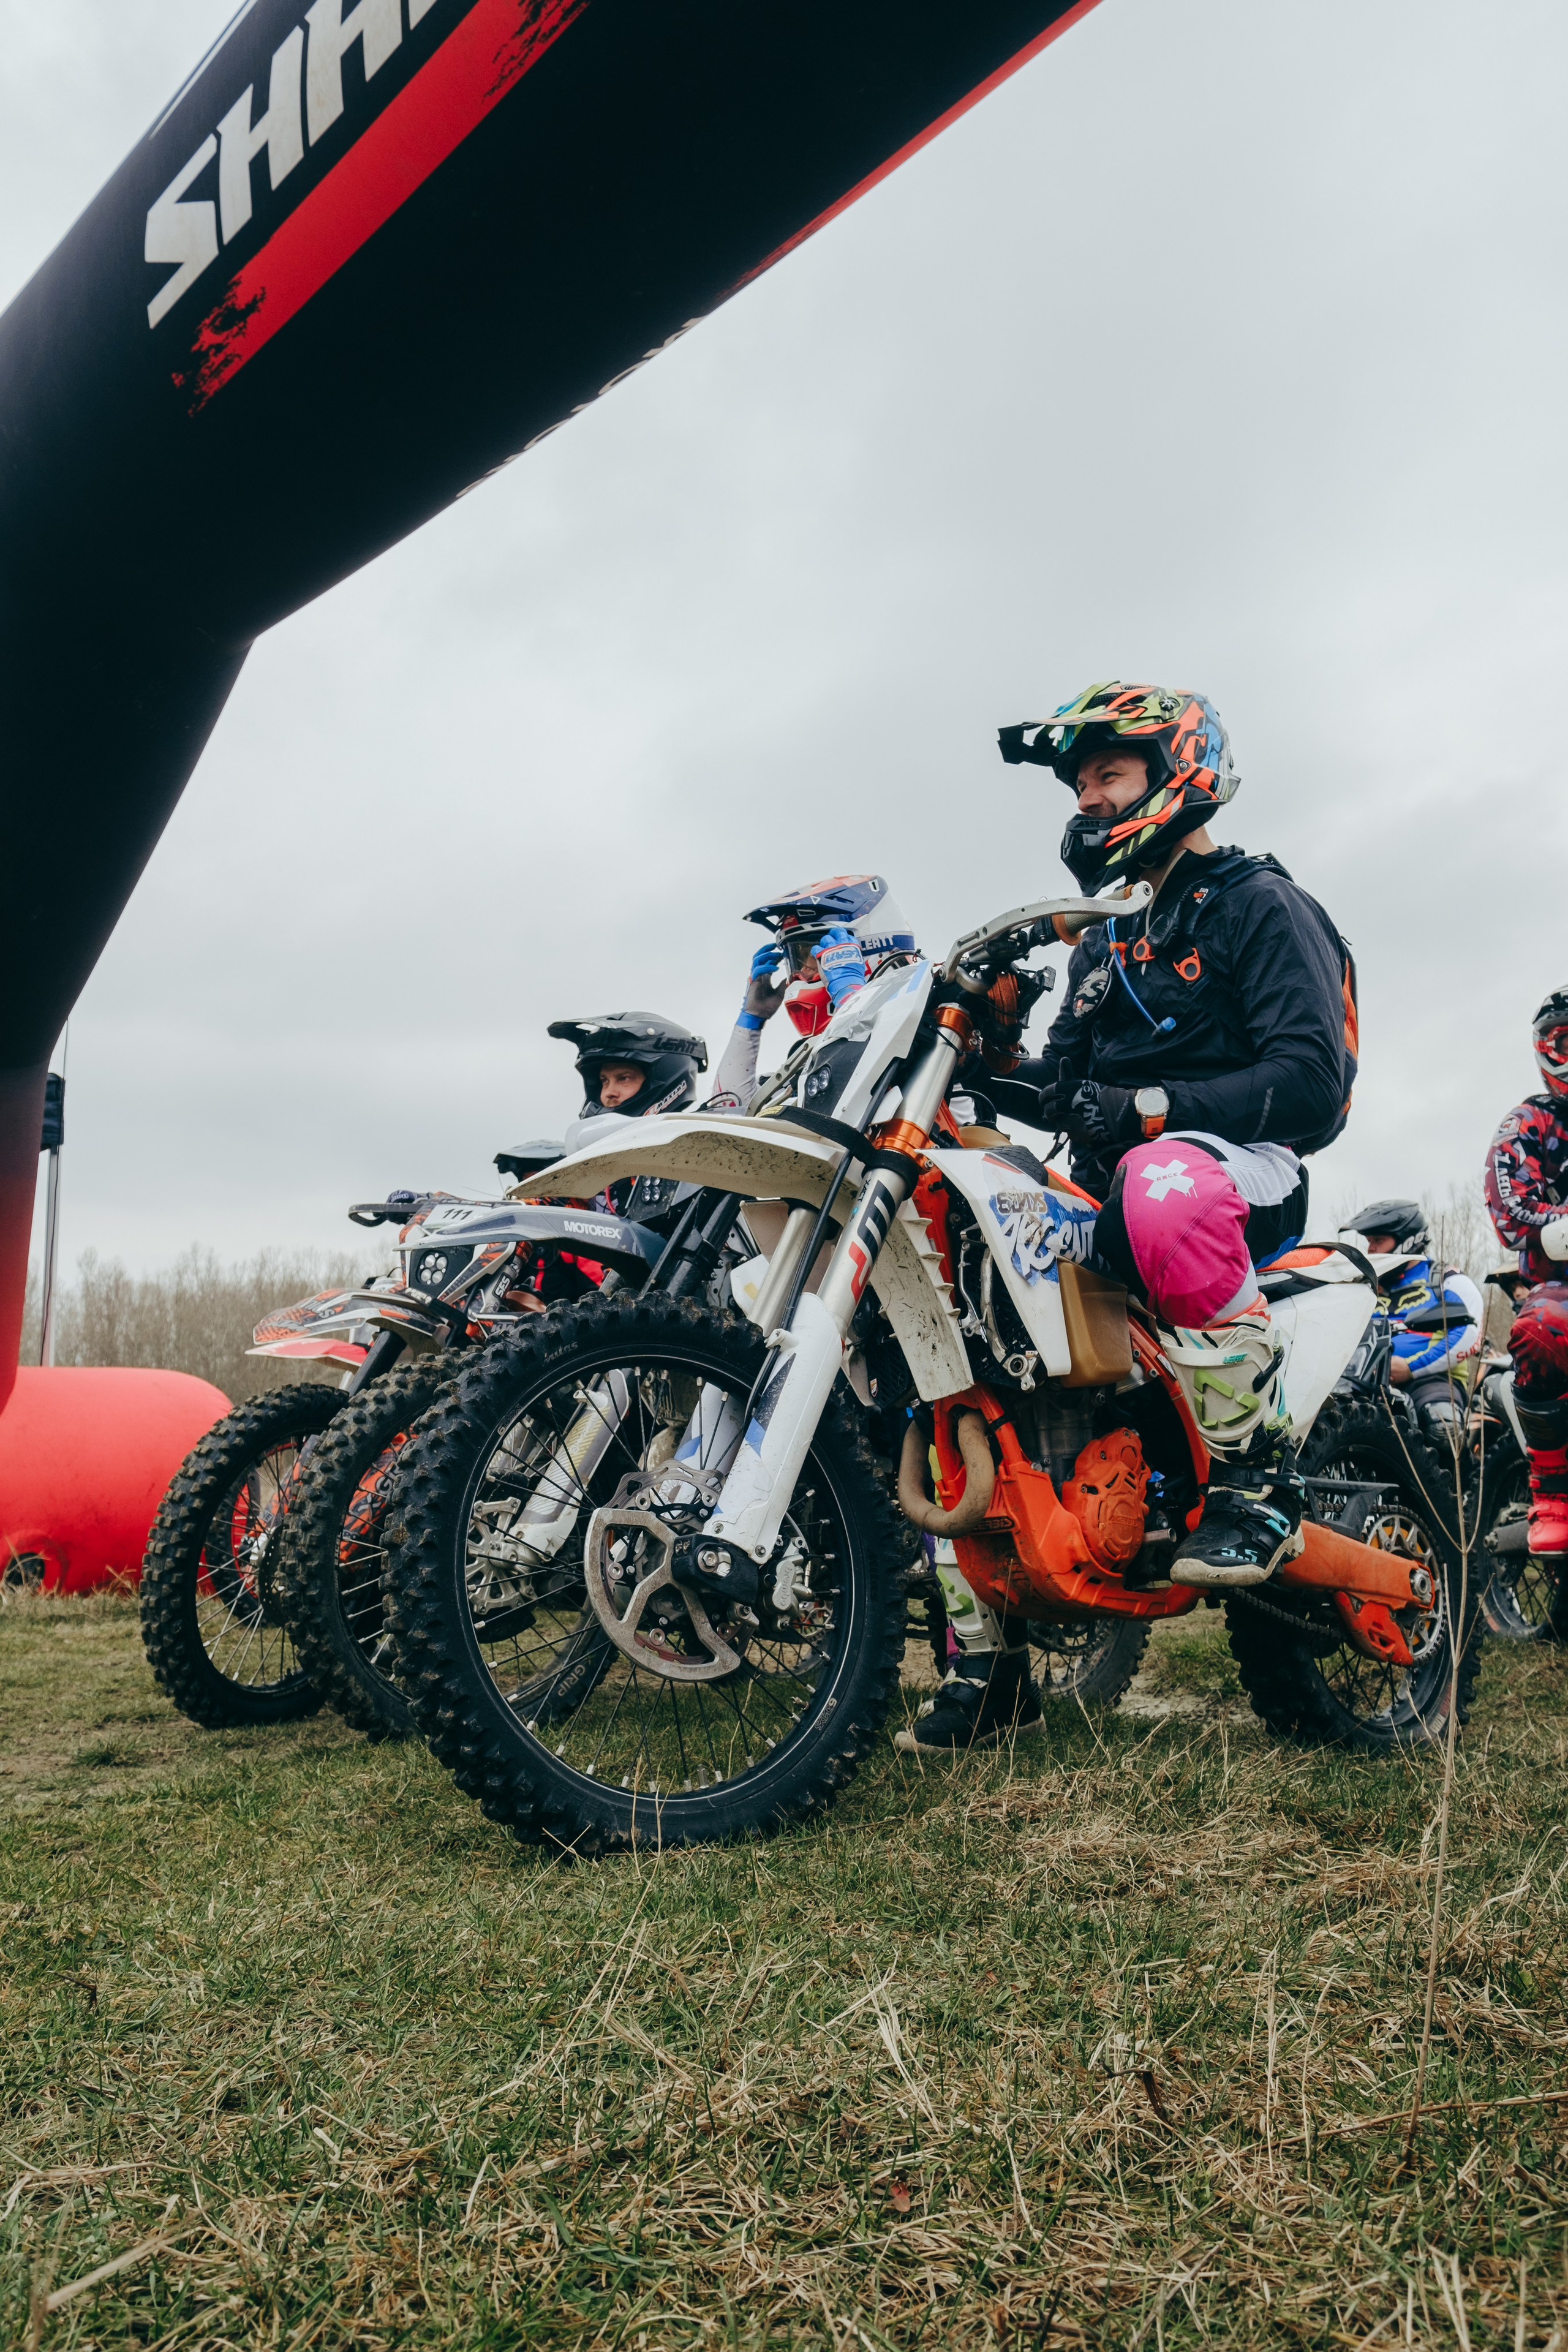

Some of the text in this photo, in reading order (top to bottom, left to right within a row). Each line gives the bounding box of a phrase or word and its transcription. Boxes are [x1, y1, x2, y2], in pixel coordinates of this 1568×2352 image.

[145, 0, 436, 329] SHH
[859, 935, 894, 951] LEATT
[653, 1037, 698, 1054] LEATT
[857, 1178, 871, 1202] XACT
[442, 1208, 473, 1220] 111
[564, 1220, 622, 1240] MOTOREX
[1223, 1352, 1248, 1364] LEATT
[558, 1664, 586, 1697] GRIP
[815, 1697, 837, 1730] 6DAYS
